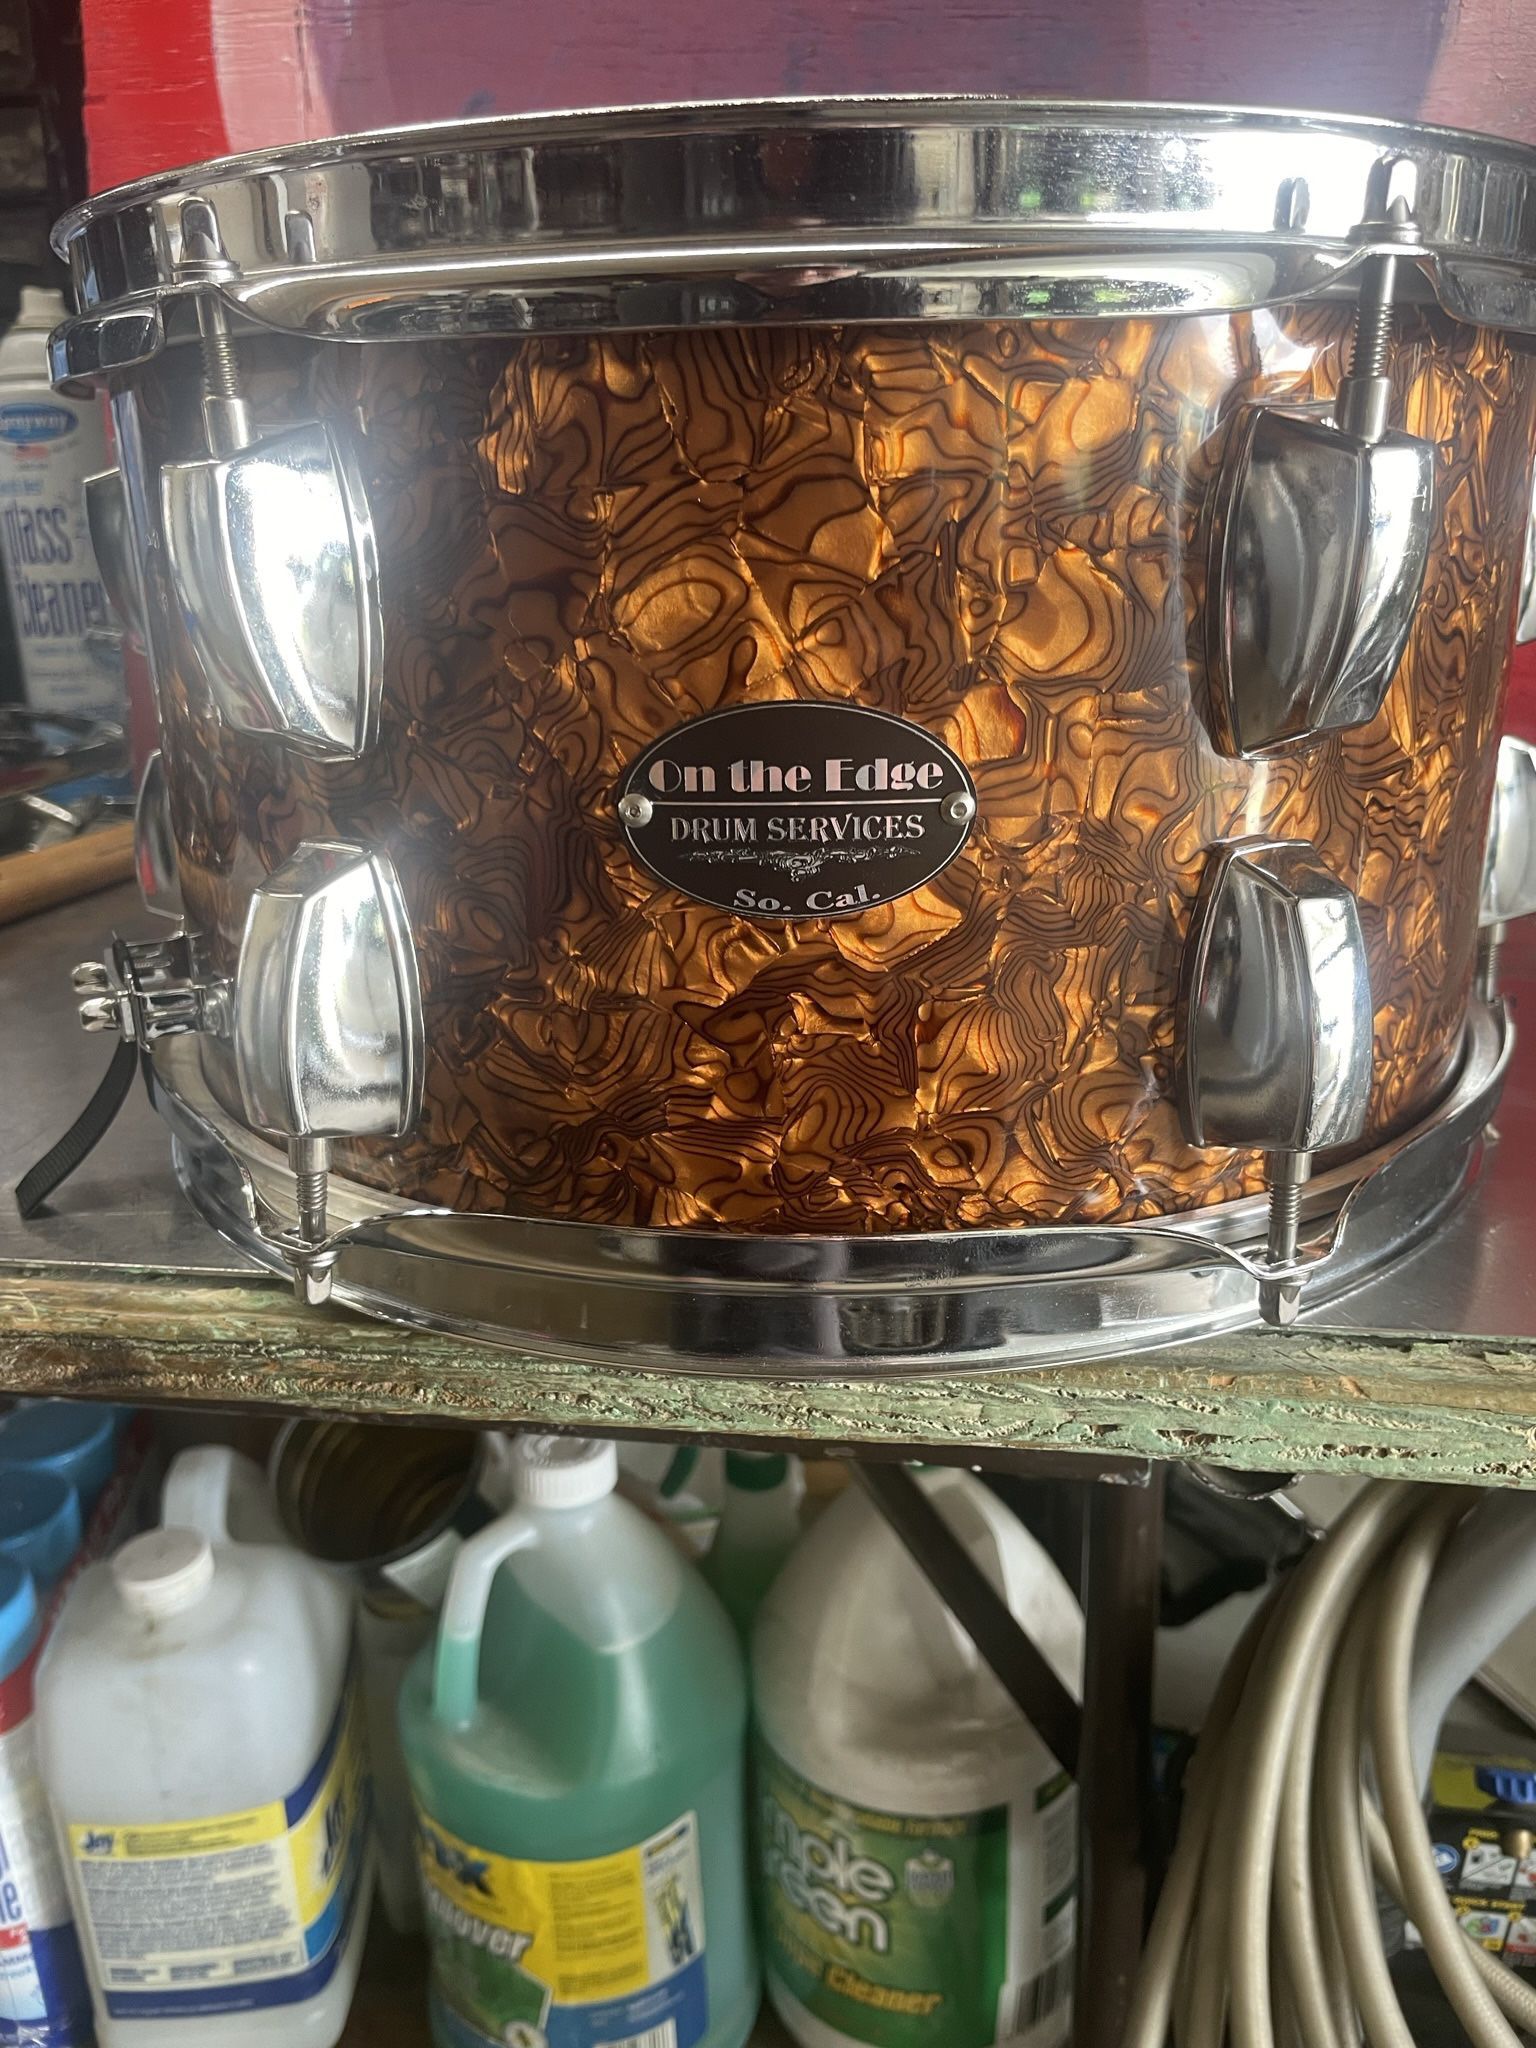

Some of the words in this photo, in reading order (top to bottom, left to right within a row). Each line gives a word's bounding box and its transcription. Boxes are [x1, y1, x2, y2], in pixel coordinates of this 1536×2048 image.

[648, 759, 716, 793] On
[728, 759, 812, 793] the
[825, 758, 944, 793] Edge
[670, 816, 758, 844] DRUM
[767, 812, 926, 844] SERVICES
[732, 887, 792, 912] So.
[805, 883, 882, 912] Cal.
